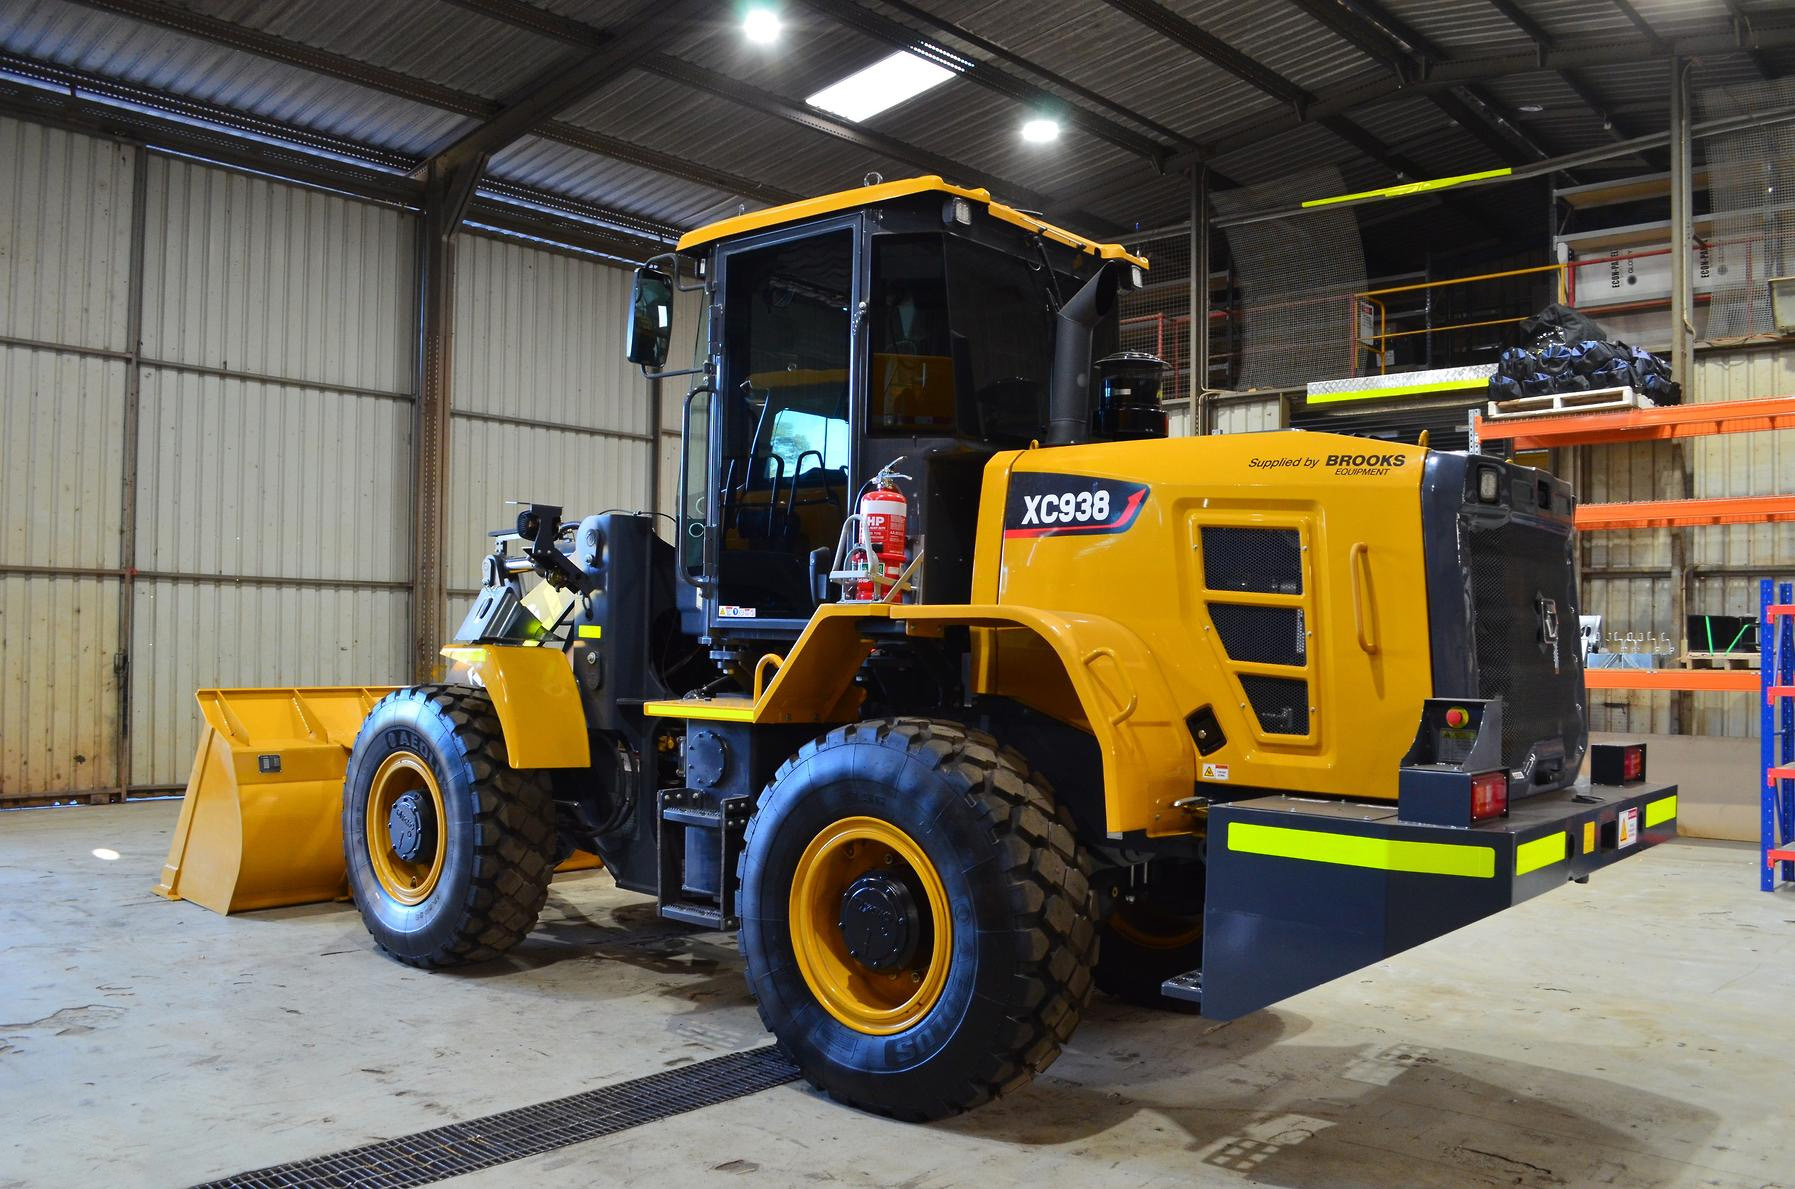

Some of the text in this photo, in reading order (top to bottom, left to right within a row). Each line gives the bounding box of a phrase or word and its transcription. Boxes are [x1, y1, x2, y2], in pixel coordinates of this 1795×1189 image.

[1611, 249, 1620, 288] ECON-PAEL
[1248, 454, 1406, 469] Supplied by BROOKS
[1335, 468, 1390, 476] EQUIPMENT
[1021, 490, 1110, 524] XC938
